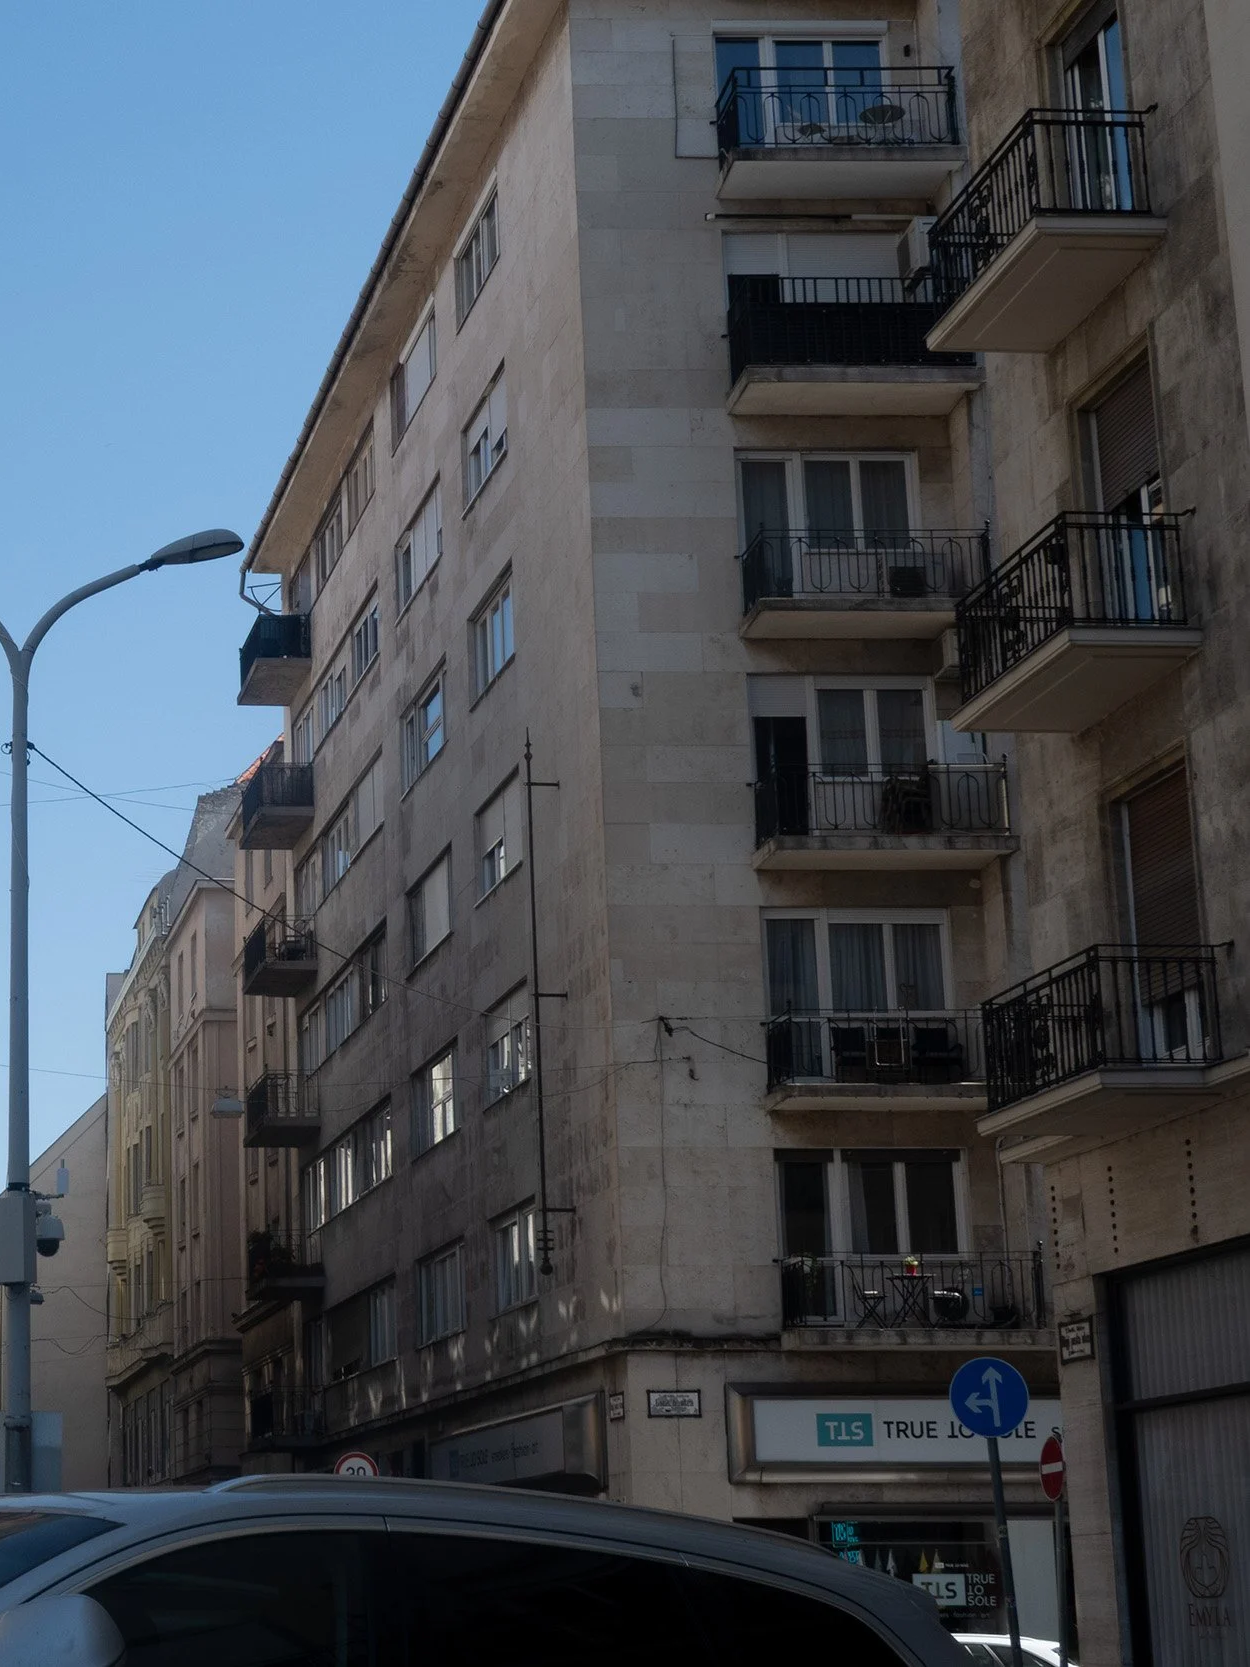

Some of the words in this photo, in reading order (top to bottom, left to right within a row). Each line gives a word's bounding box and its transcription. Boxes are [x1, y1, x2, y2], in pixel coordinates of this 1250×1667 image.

[883, 1420, 939, 1439] TRUE
[966, 1574, 996, 1585] TRUE
[967, 1596, 997, 1607] SOLE
